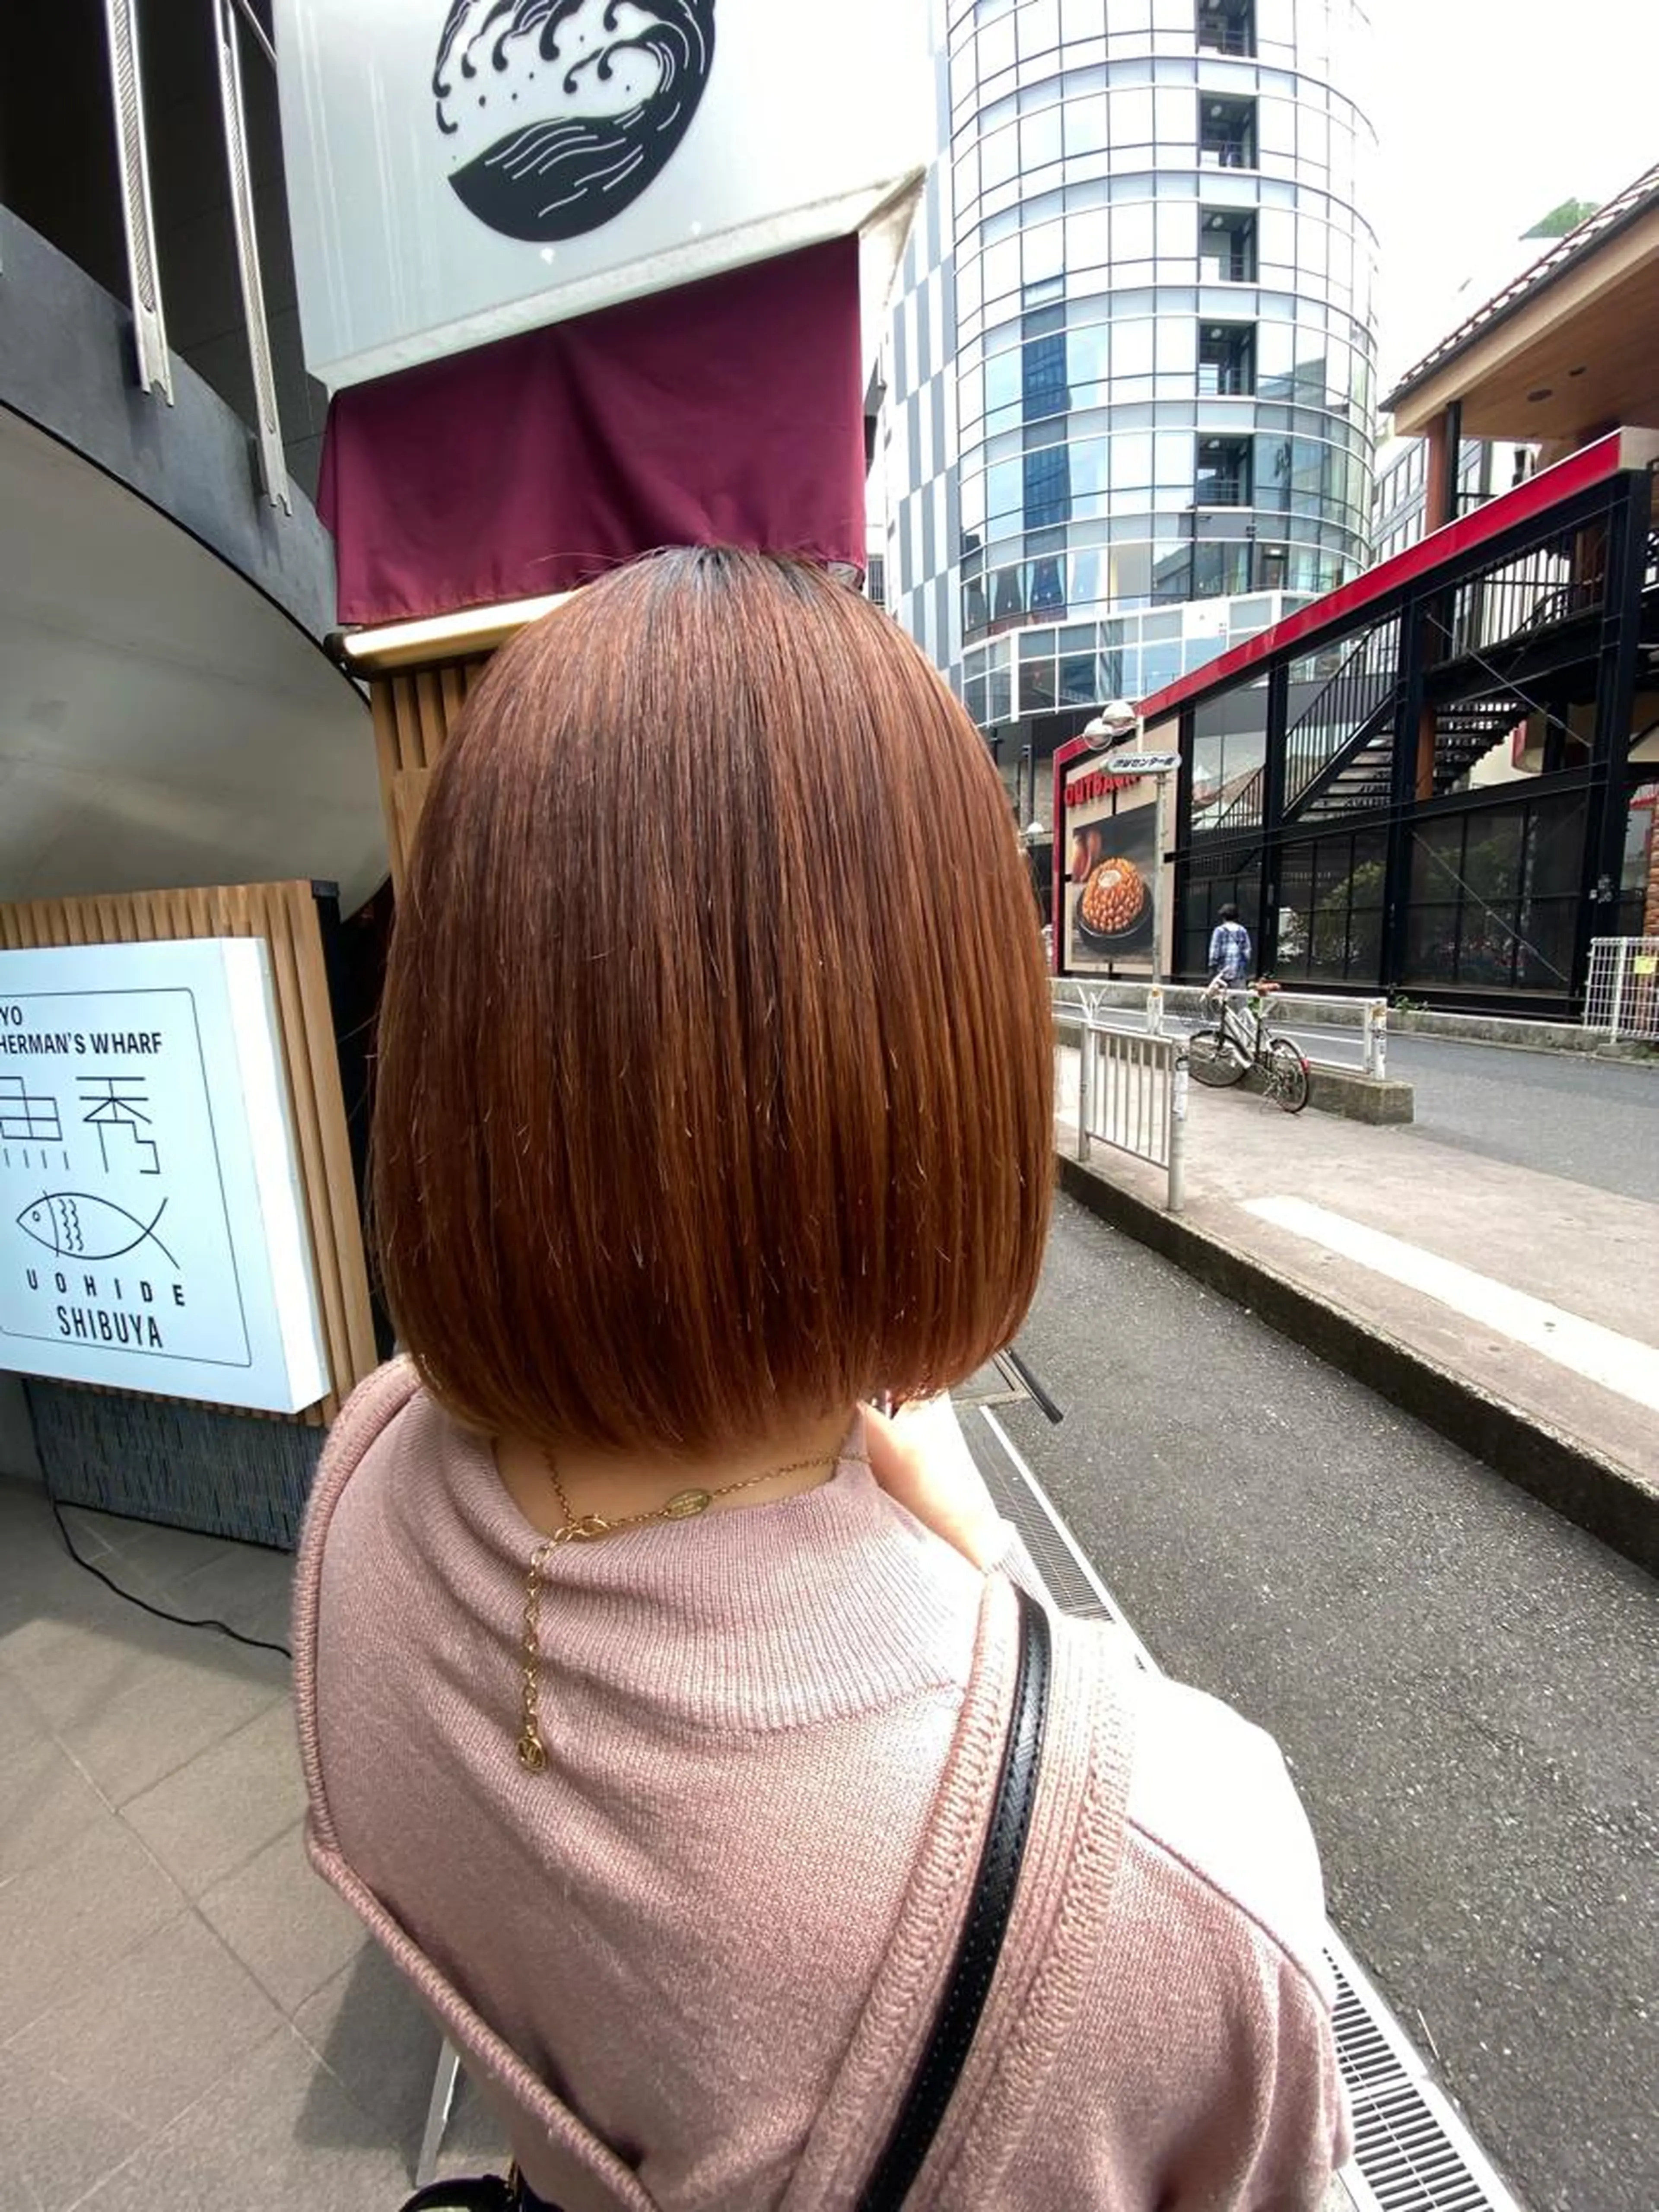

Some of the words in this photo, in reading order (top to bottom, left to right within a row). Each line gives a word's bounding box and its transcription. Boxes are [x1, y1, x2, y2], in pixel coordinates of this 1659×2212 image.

[90, 1033, 162, 1054] WHARF
[26, 1268, 185, 1306] UOHIDE
[57, 1306, 163, 1348] SHIBUYA
